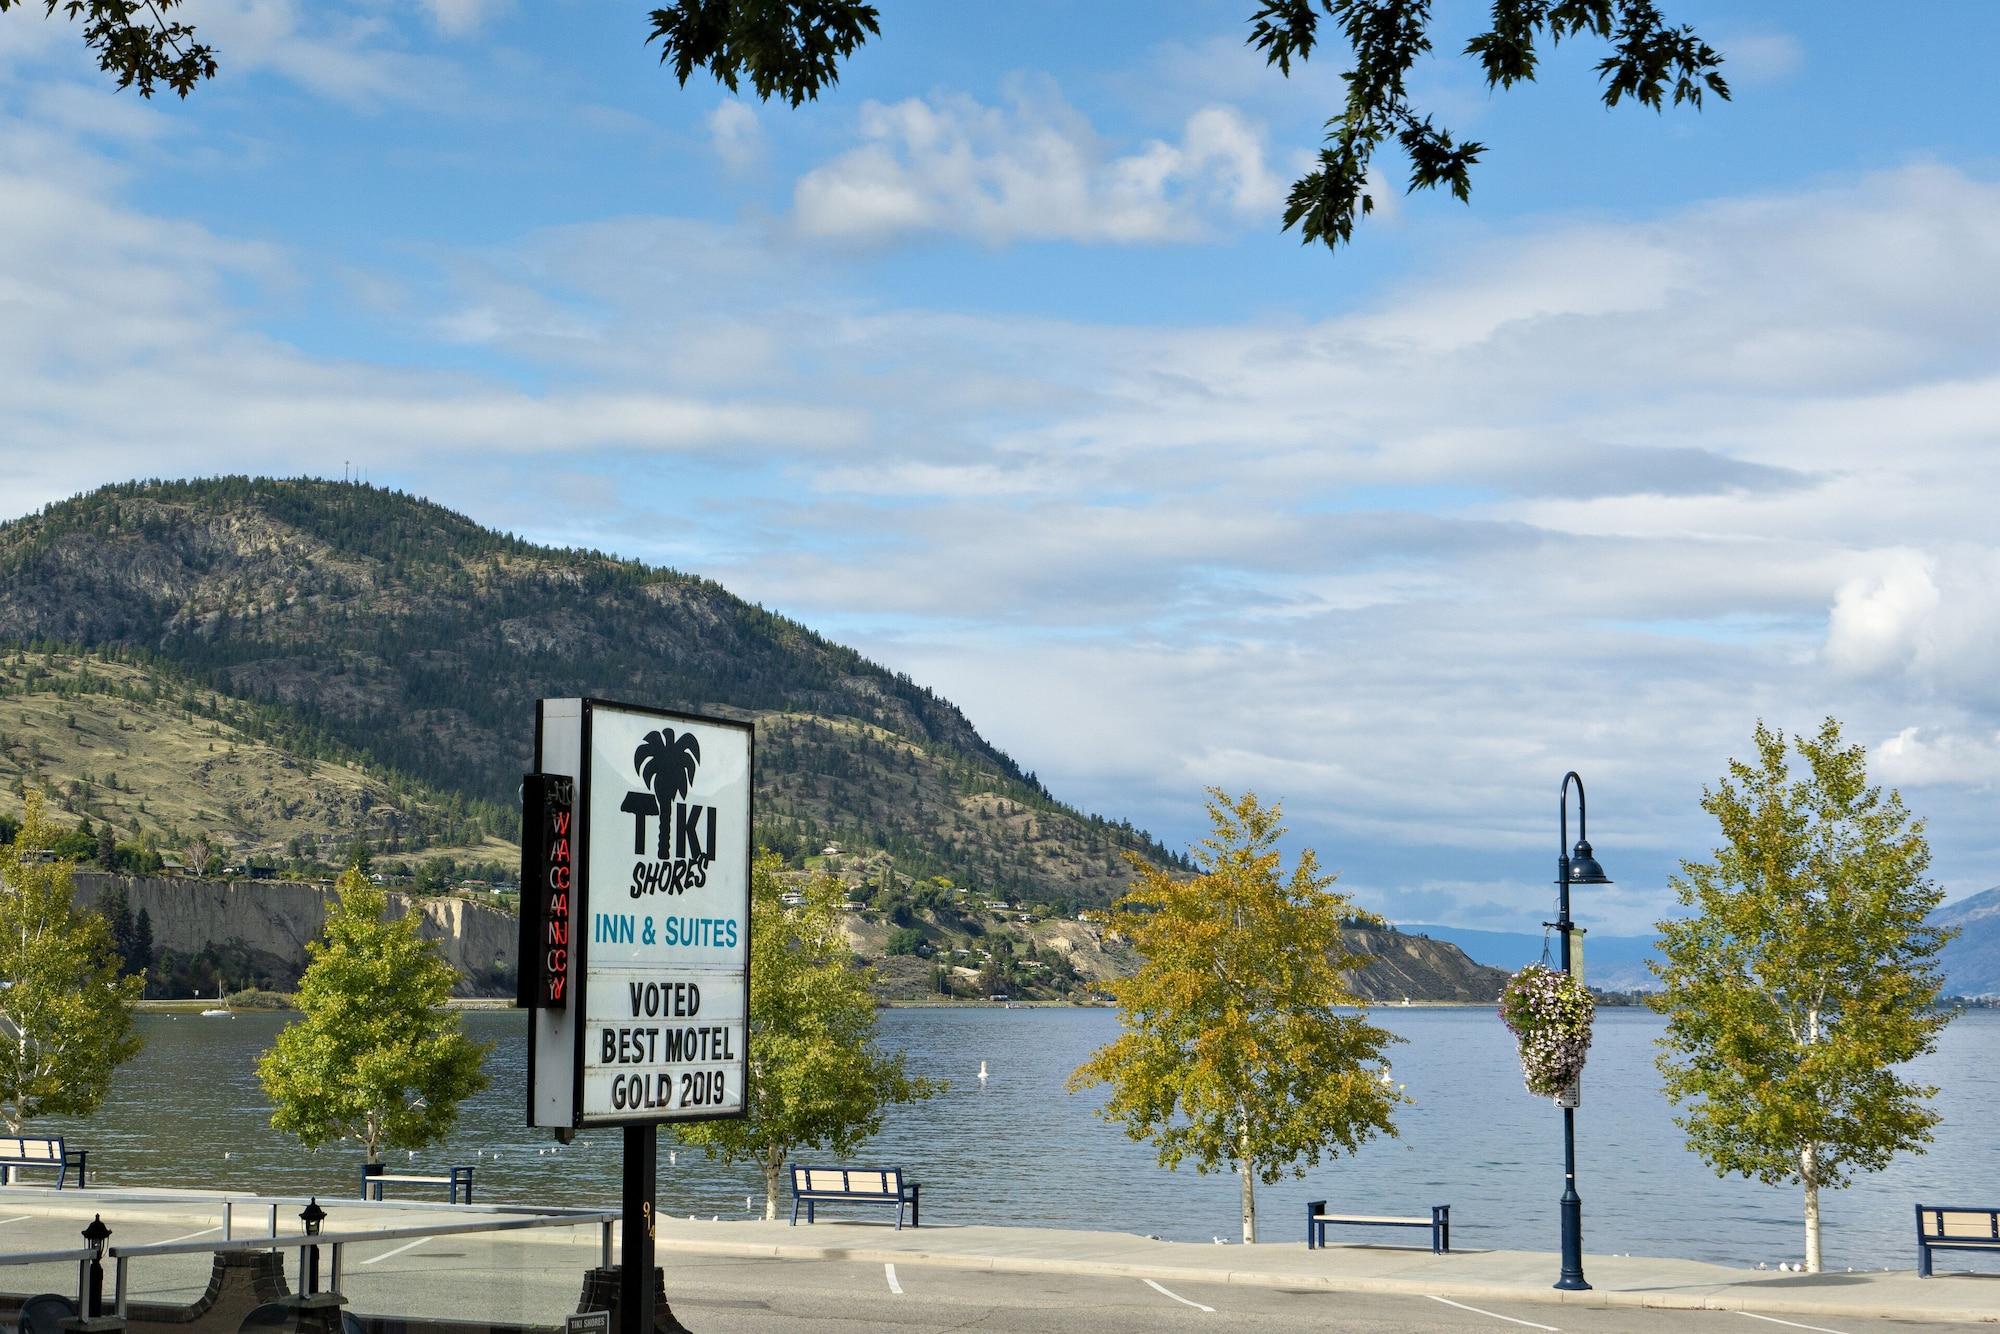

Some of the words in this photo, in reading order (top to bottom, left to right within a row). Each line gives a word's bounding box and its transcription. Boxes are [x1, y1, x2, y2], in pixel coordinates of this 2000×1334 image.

[620, 790, 717, 862] TIKI
[630, 852, 709, 899] SHORES
[595, 913, 635, 944] INN
[642, 916, 656, 945] &
[665, 916, 738, 948] SUITES
[629, 982, 700, 1018] VOTED
[601, 1027, 659, 1064] BEST
[665, 1026, 734, 1062] MOTEL
[611, 1073, 672, 1110] GOLD
[680, 1071, 725, 1107] 2019
